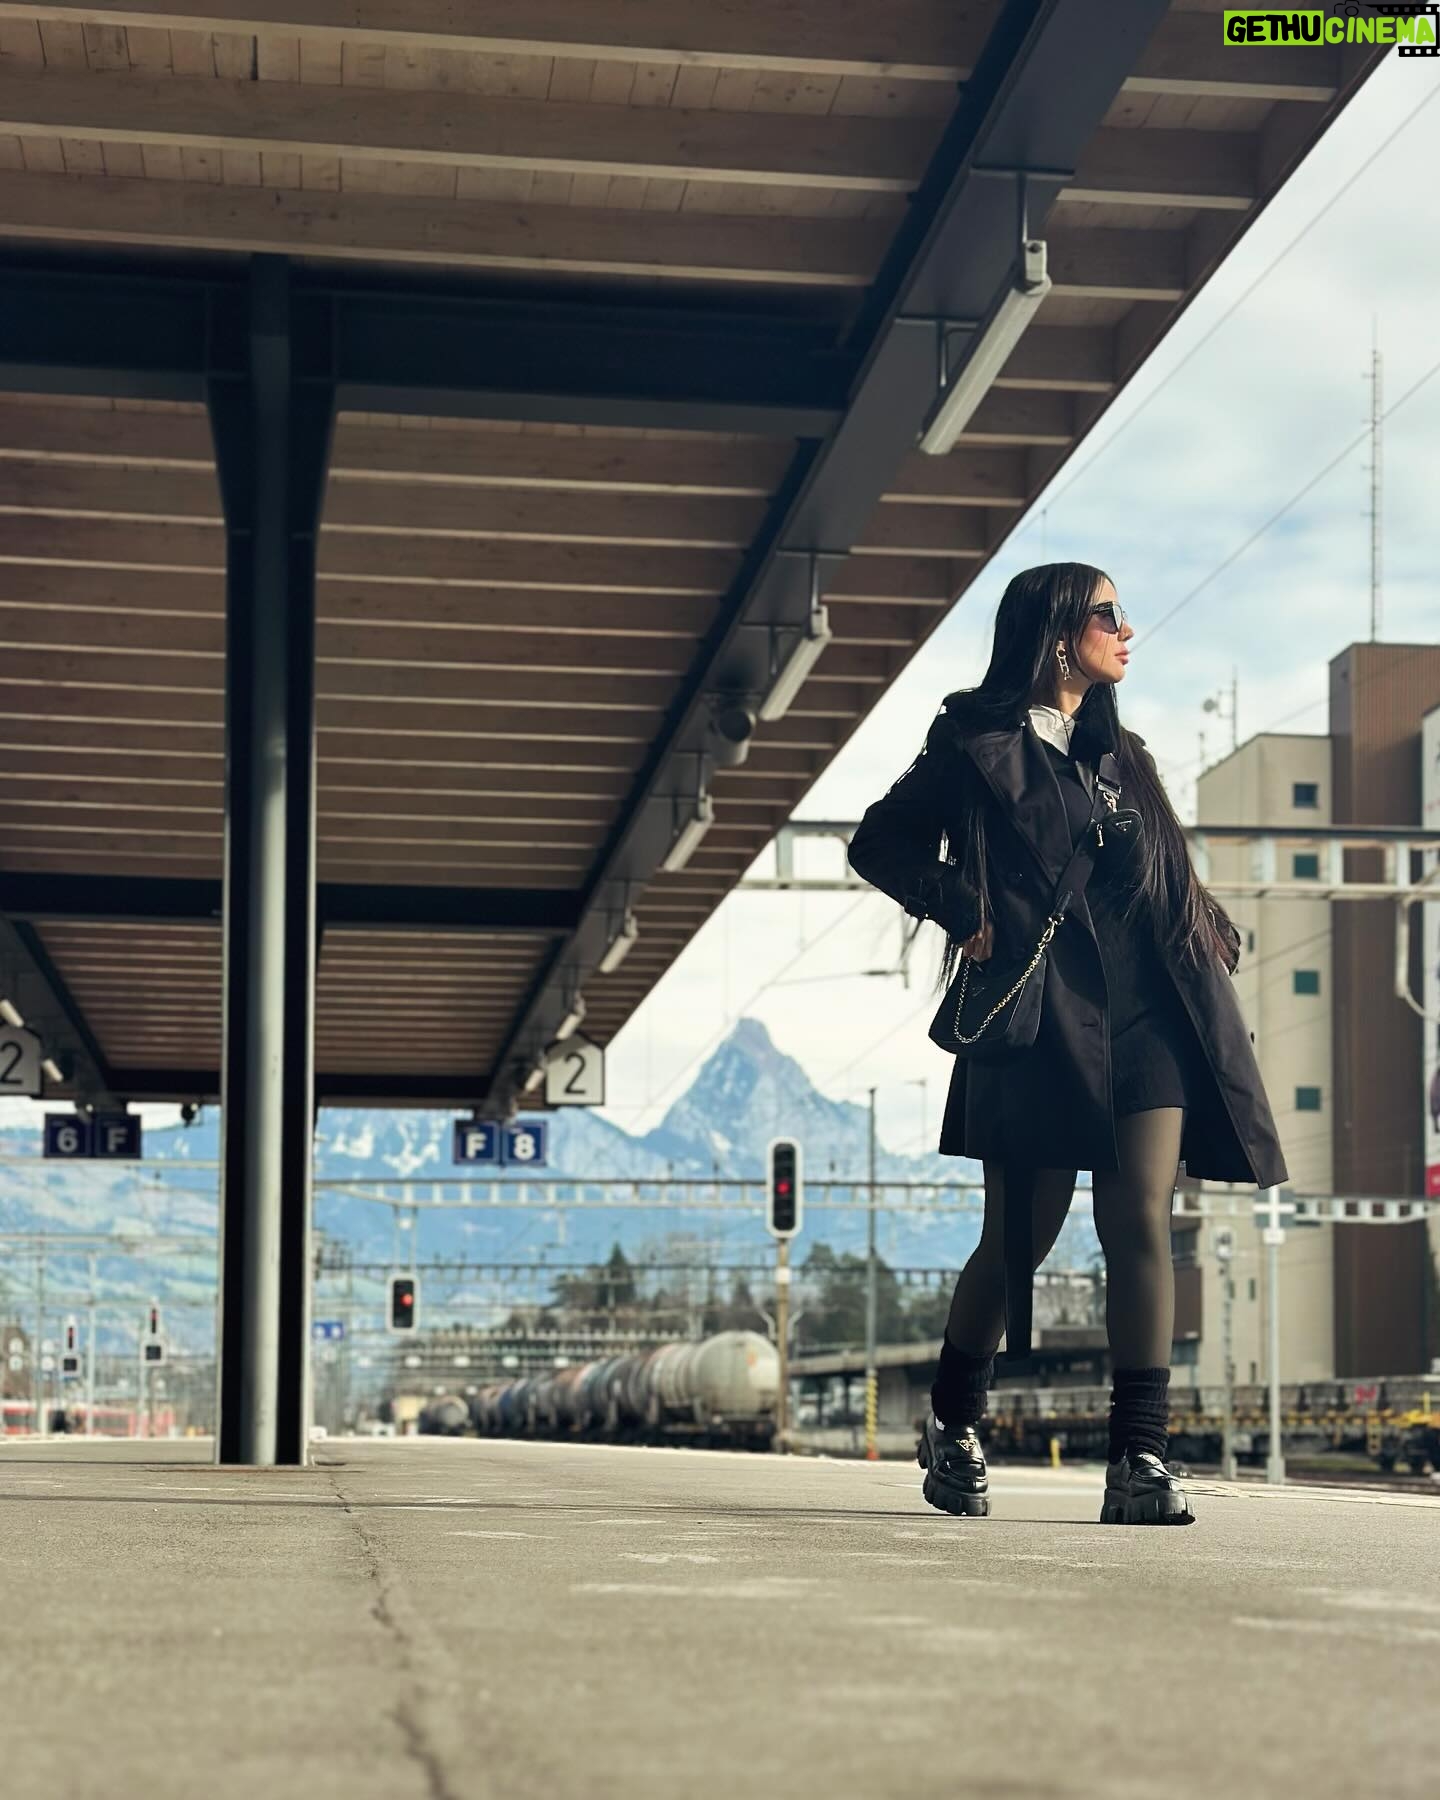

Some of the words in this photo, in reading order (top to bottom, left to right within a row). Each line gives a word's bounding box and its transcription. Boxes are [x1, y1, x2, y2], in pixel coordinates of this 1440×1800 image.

[0, 1041, 23, 1085] 2
[564, 1052, 586, 1095] 2
[57, 1127, 78, 1152] 6
[107, 1127, 128, 1152] F
[466, 1132, 487, 1159] F
[513, 1133, 535, 1160] 8
